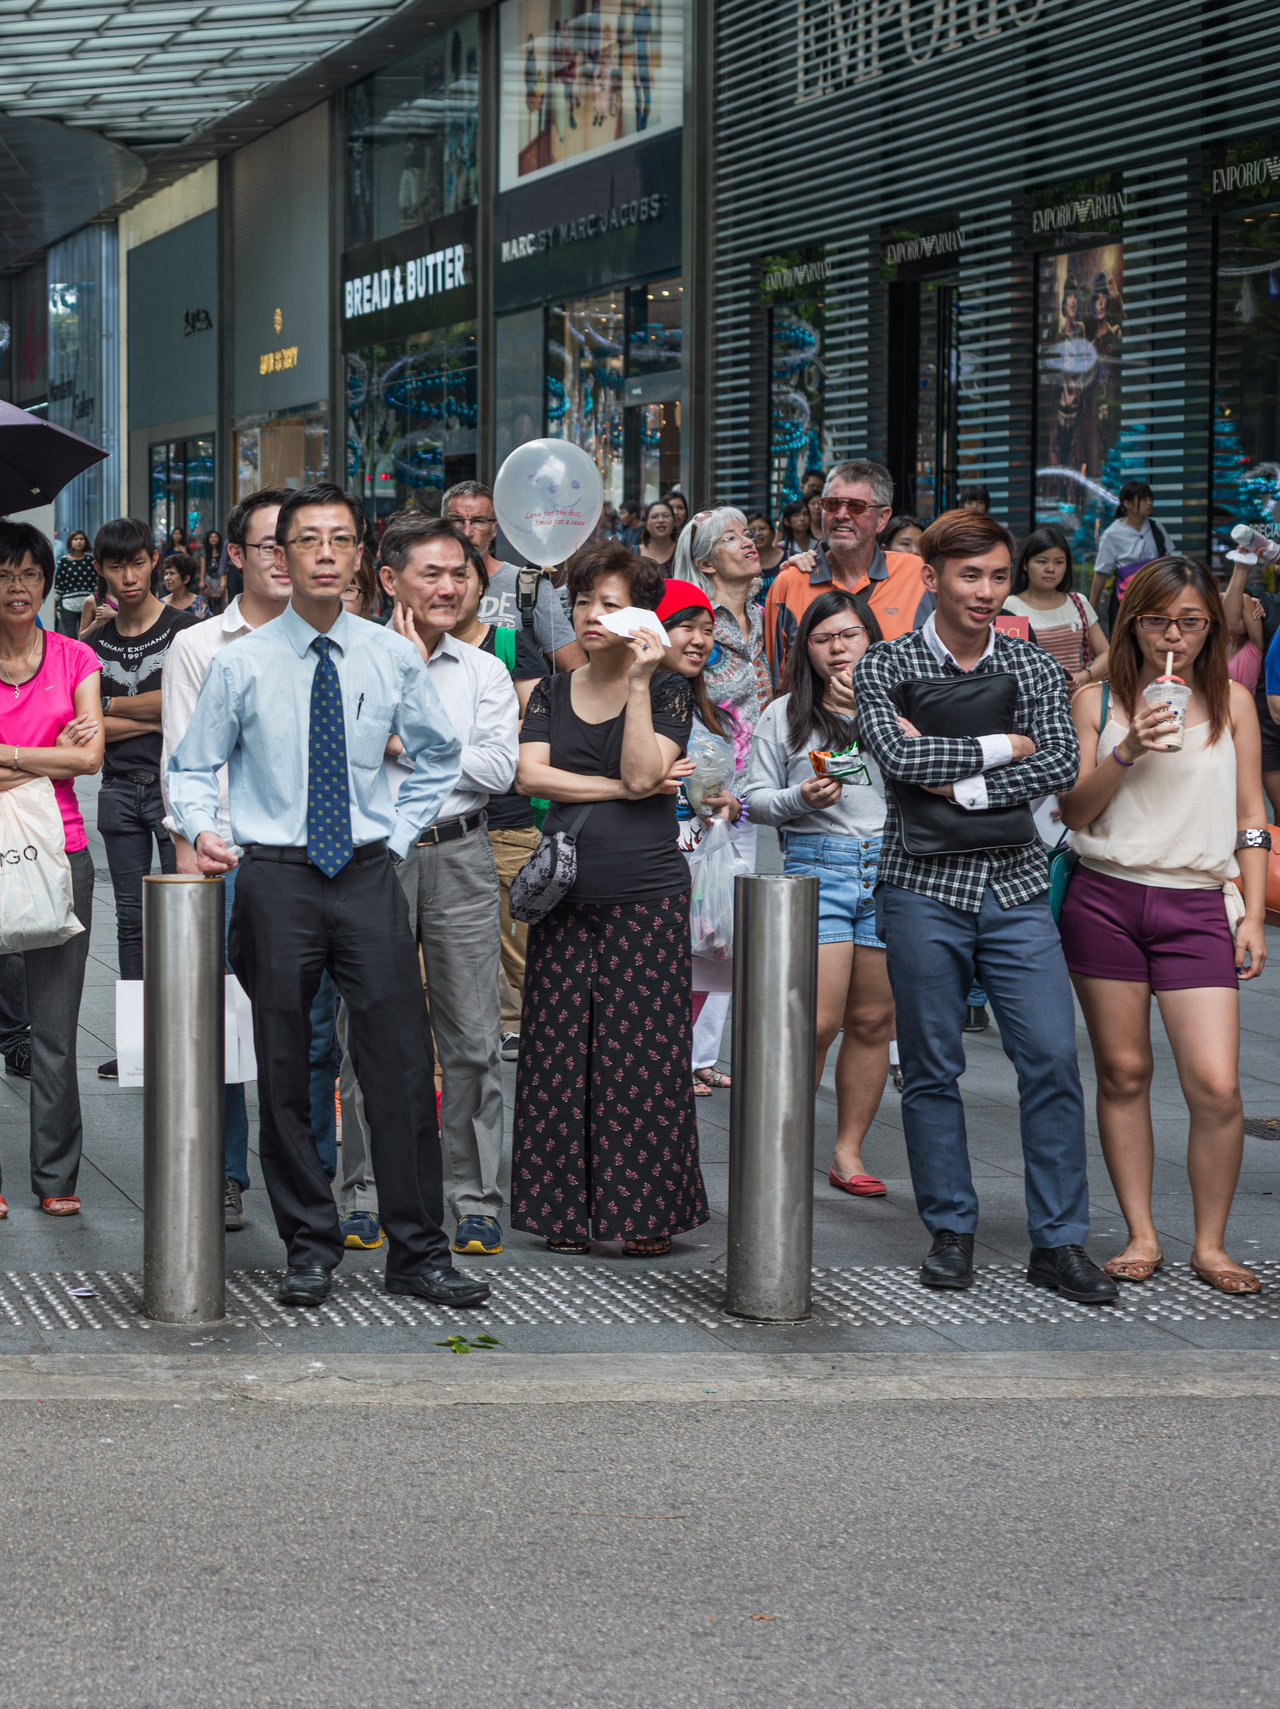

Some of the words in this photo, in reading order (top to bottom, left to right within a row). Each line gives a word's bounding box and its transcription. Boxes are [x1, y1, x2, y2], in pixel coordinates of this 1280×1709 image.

[1212, 158, 1267, 194] EMPORIO
[501, 233, 536, 262] MARC
[559, 214, 597, 245] MARC
[601, 193, 661, 232] JACOBS
[1032, 203, 1077, 234] EMPORIO
[1089, 192, 1128, 219] ARMAN
[345, 268, 391, 319] BREAD
[393, 265, 404, 305] &
[406, 243, 466, 301] BUTTER
[524, 512, 542, 520] Love
[542, 508, 554, 519] for
[556, 508, 567, 516] the
[534, 518, 552, 526] Smile
[552, 517, 564, 527] for
[122, 652, 143, 660] 1991
